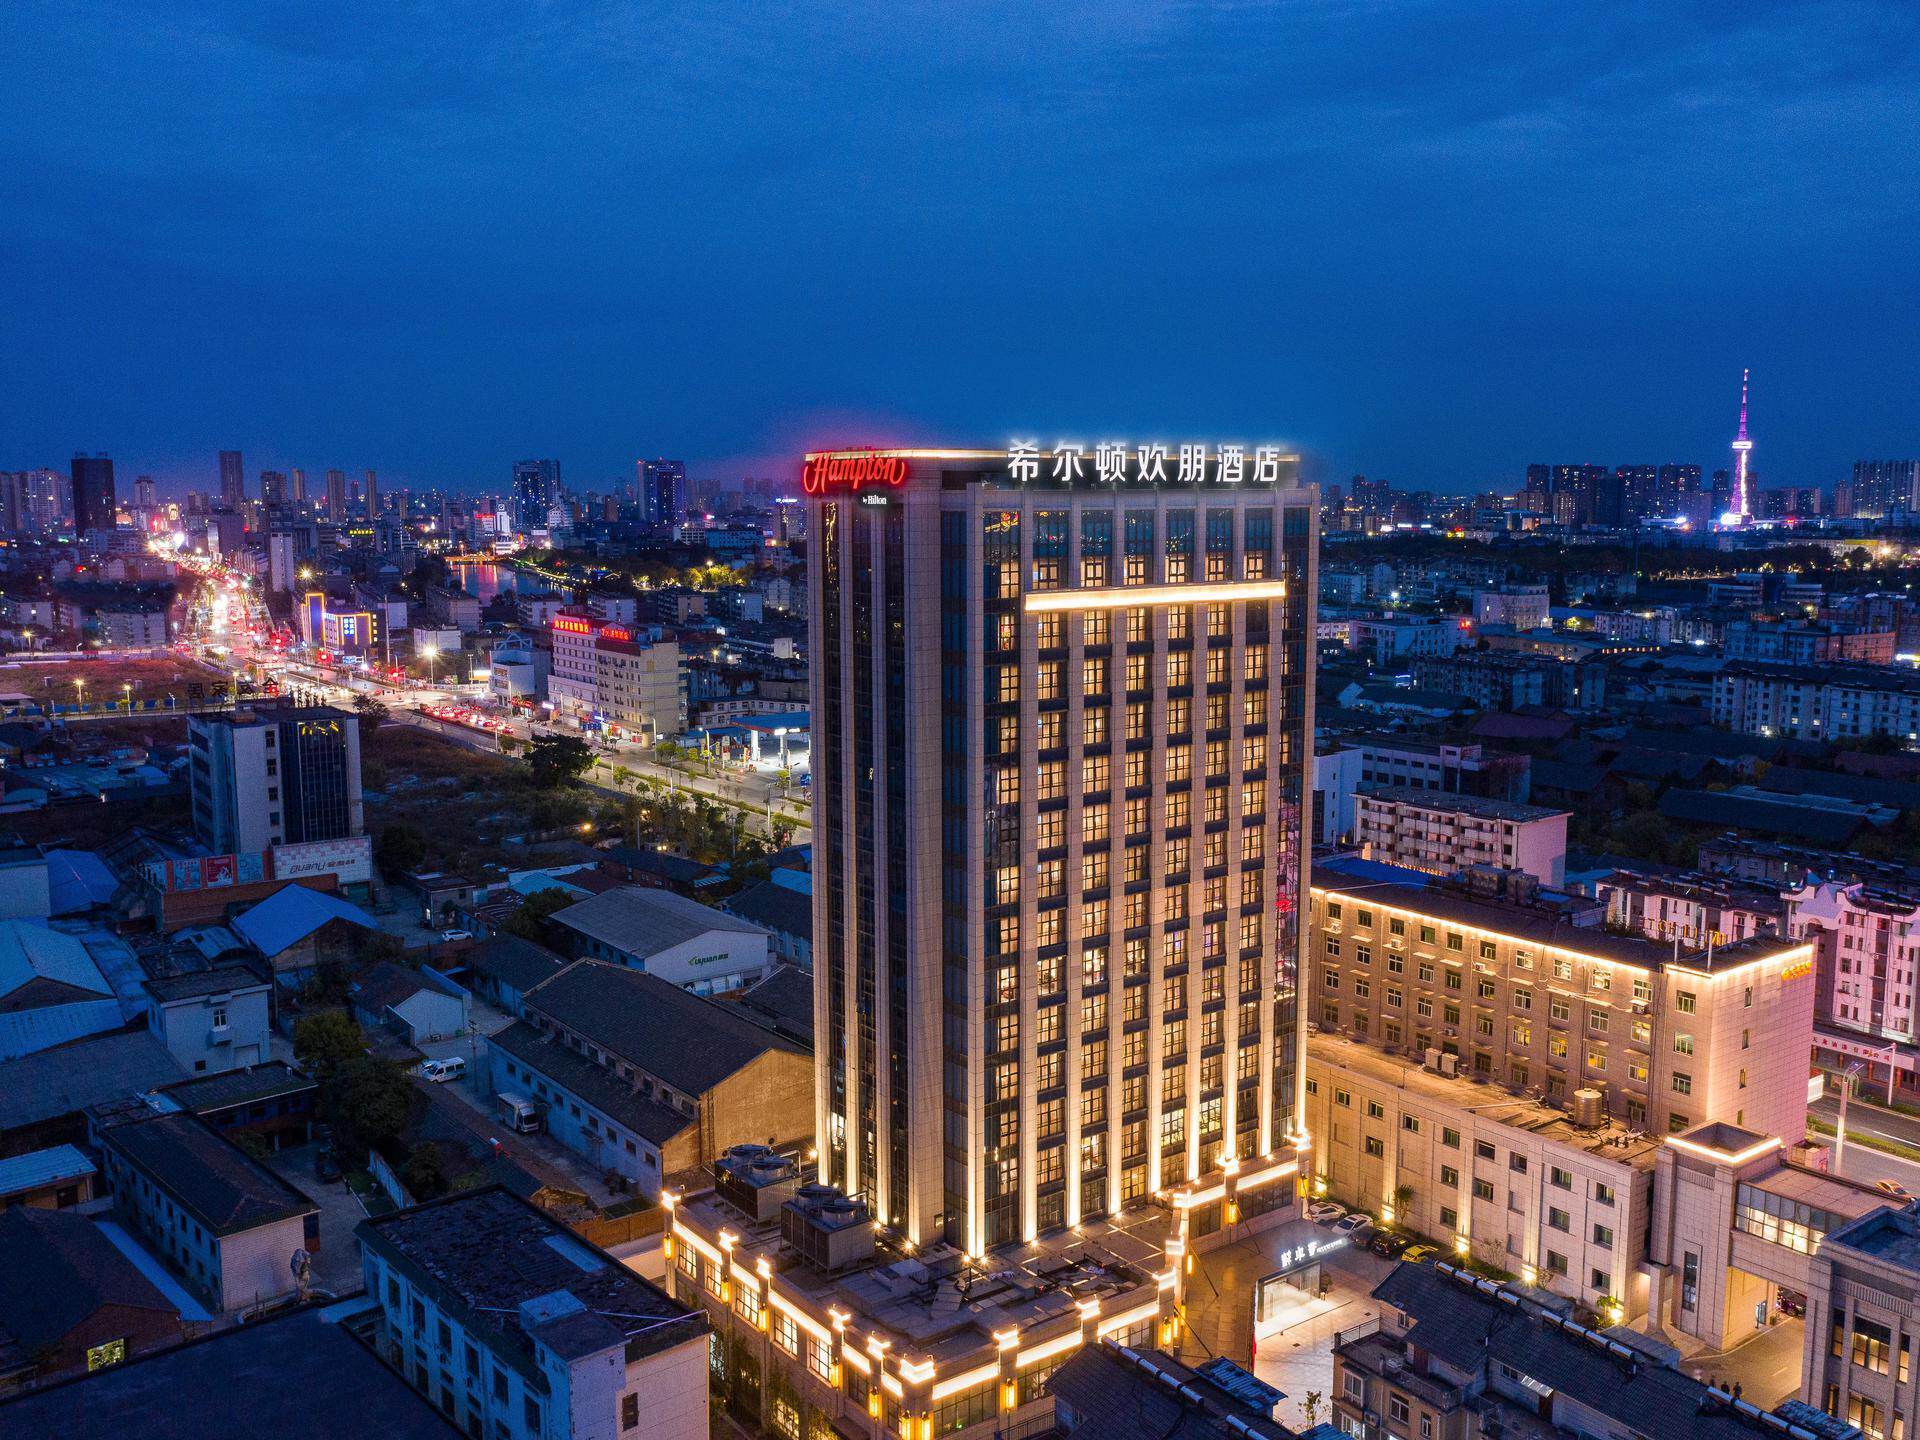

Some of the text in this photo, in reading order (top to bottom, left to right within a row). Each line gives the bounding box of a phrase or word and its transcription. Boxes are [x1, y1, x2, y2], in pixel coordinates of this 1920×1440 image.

[804, 451, 905, 493] Hampton
[1008, 439, 1280, 482] 希尔顿欢朋酒店
[868, 495, 887, 505] Hilton
